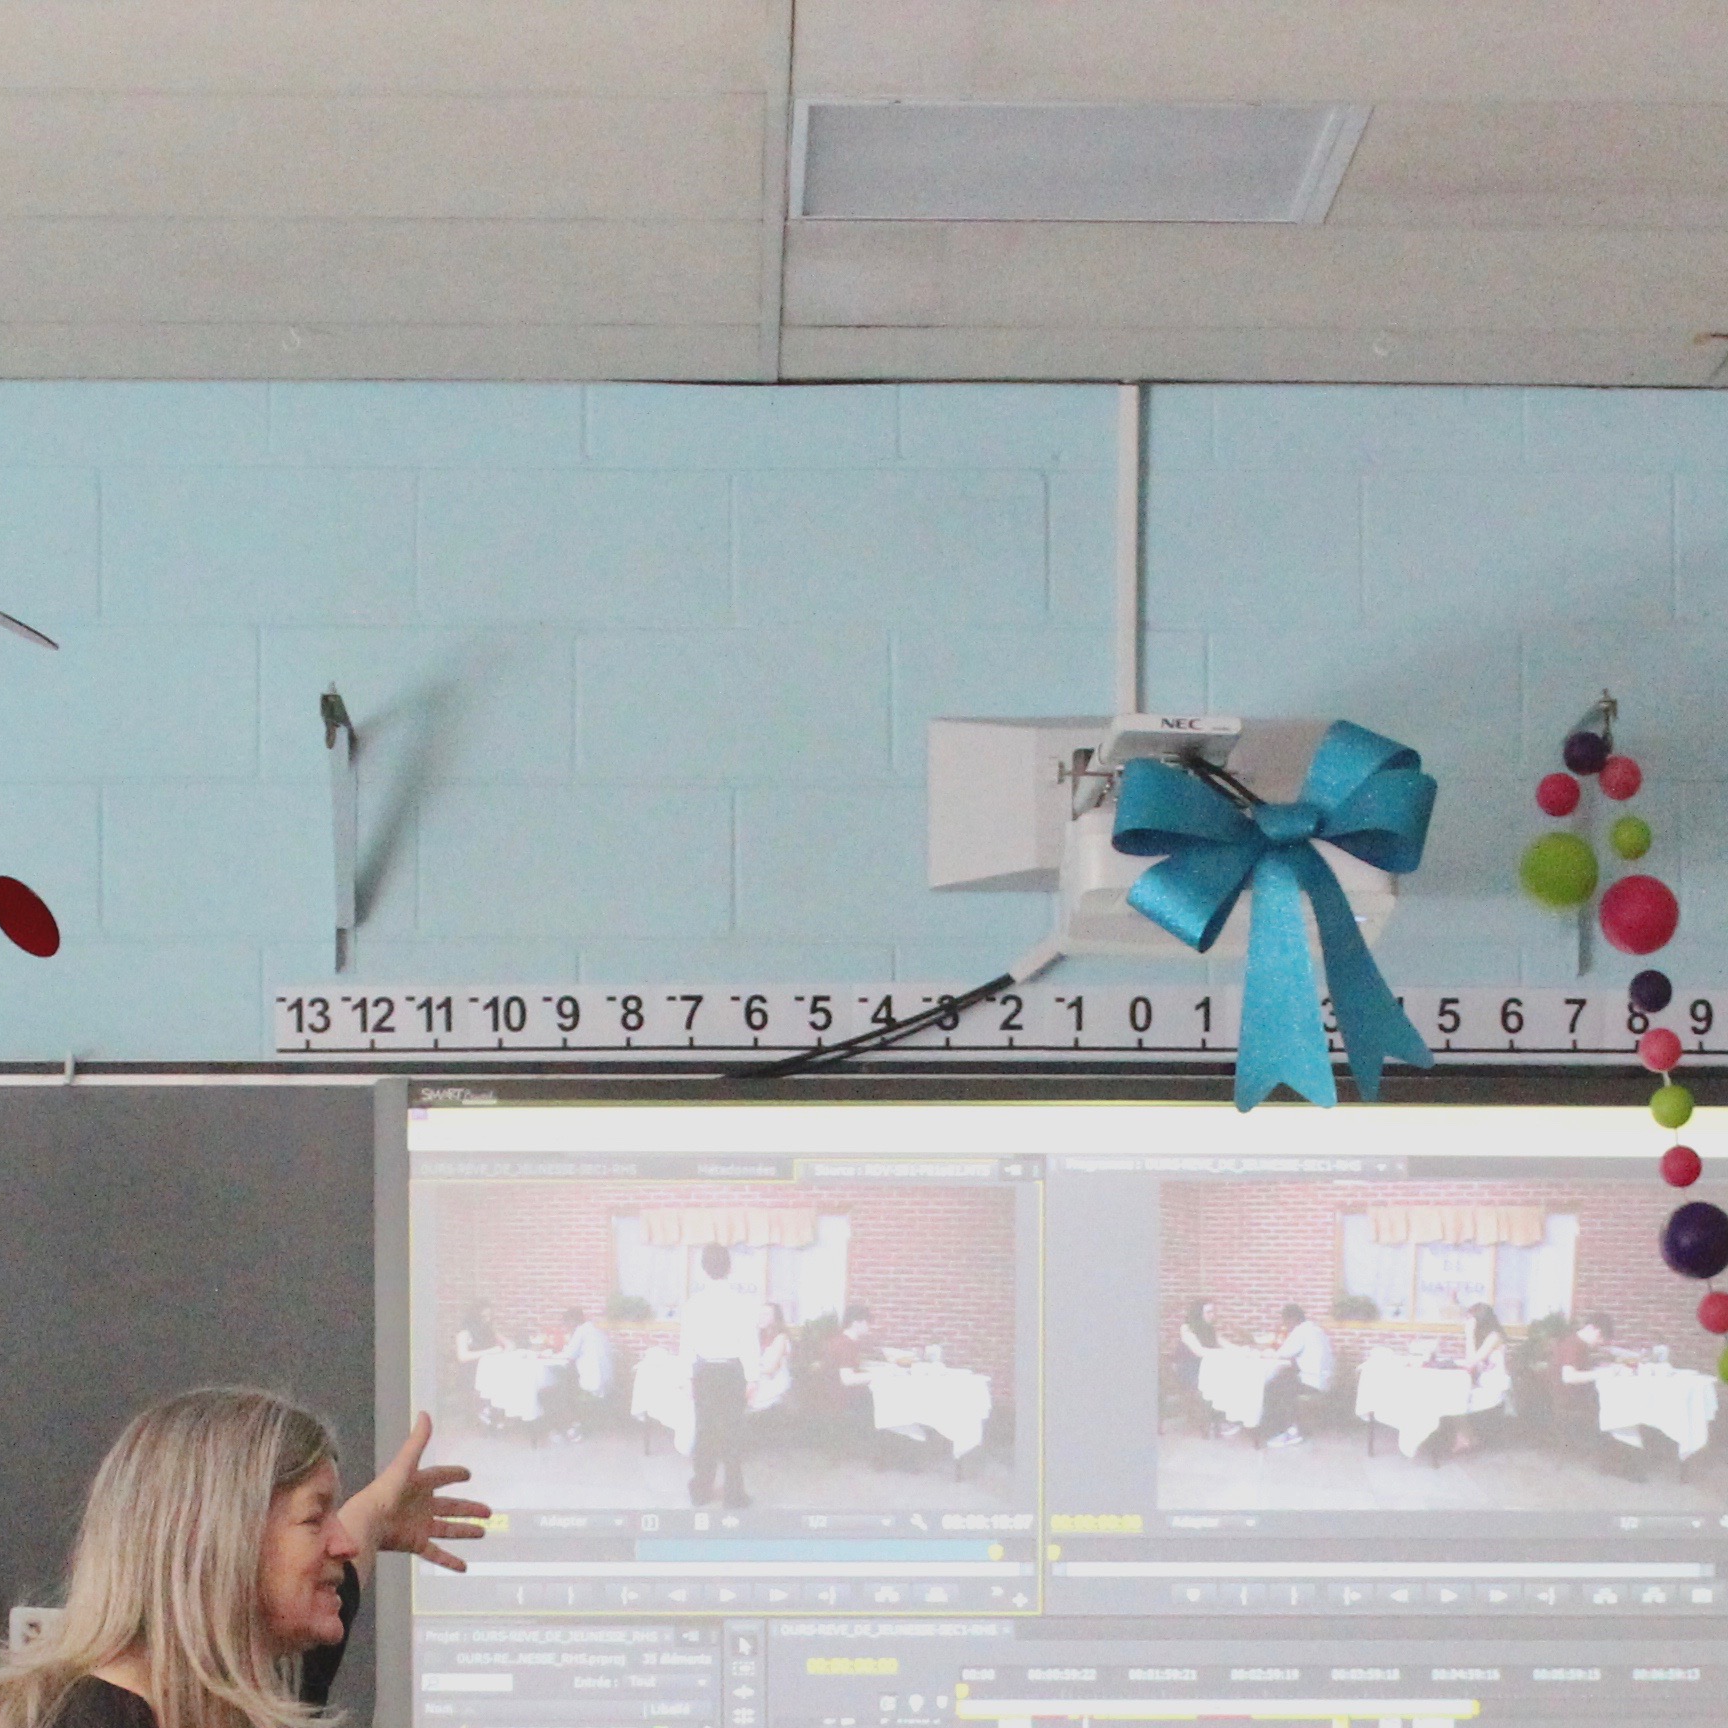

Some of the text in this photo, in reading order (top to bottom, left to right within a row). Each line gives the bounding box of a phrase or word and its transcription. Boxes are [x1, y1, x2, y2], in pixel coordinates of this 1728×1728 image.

[1161, 717, 1199, 730] NEC
[275, 996, 331, 1033] -13
[340, 996, 395, 1033] -12
[405, 996, 453, 1033] -11
[470, 996, 526, 1033] -10
[543, 996, 579, 1033] -9
[606, 996, 644, 1031] -8
[667, 996, 704, 1030] -7
[730, 996, 768, 1031] -6
[794, 996, 831, 1031] -5
[986, 996, 1024, 1031] -2
[1055, 996, 1084, 1031] -1
[1129, 996, 1152, 1032] 0
[1194, 996, 1211, 1031] 1
[1438, 999, 1462, 1034] 5
[1501, 999, 1525, 1034] 6
[1564, 999, 1587, 1034] 7
[1690, 999, 1714, 1035] 9
